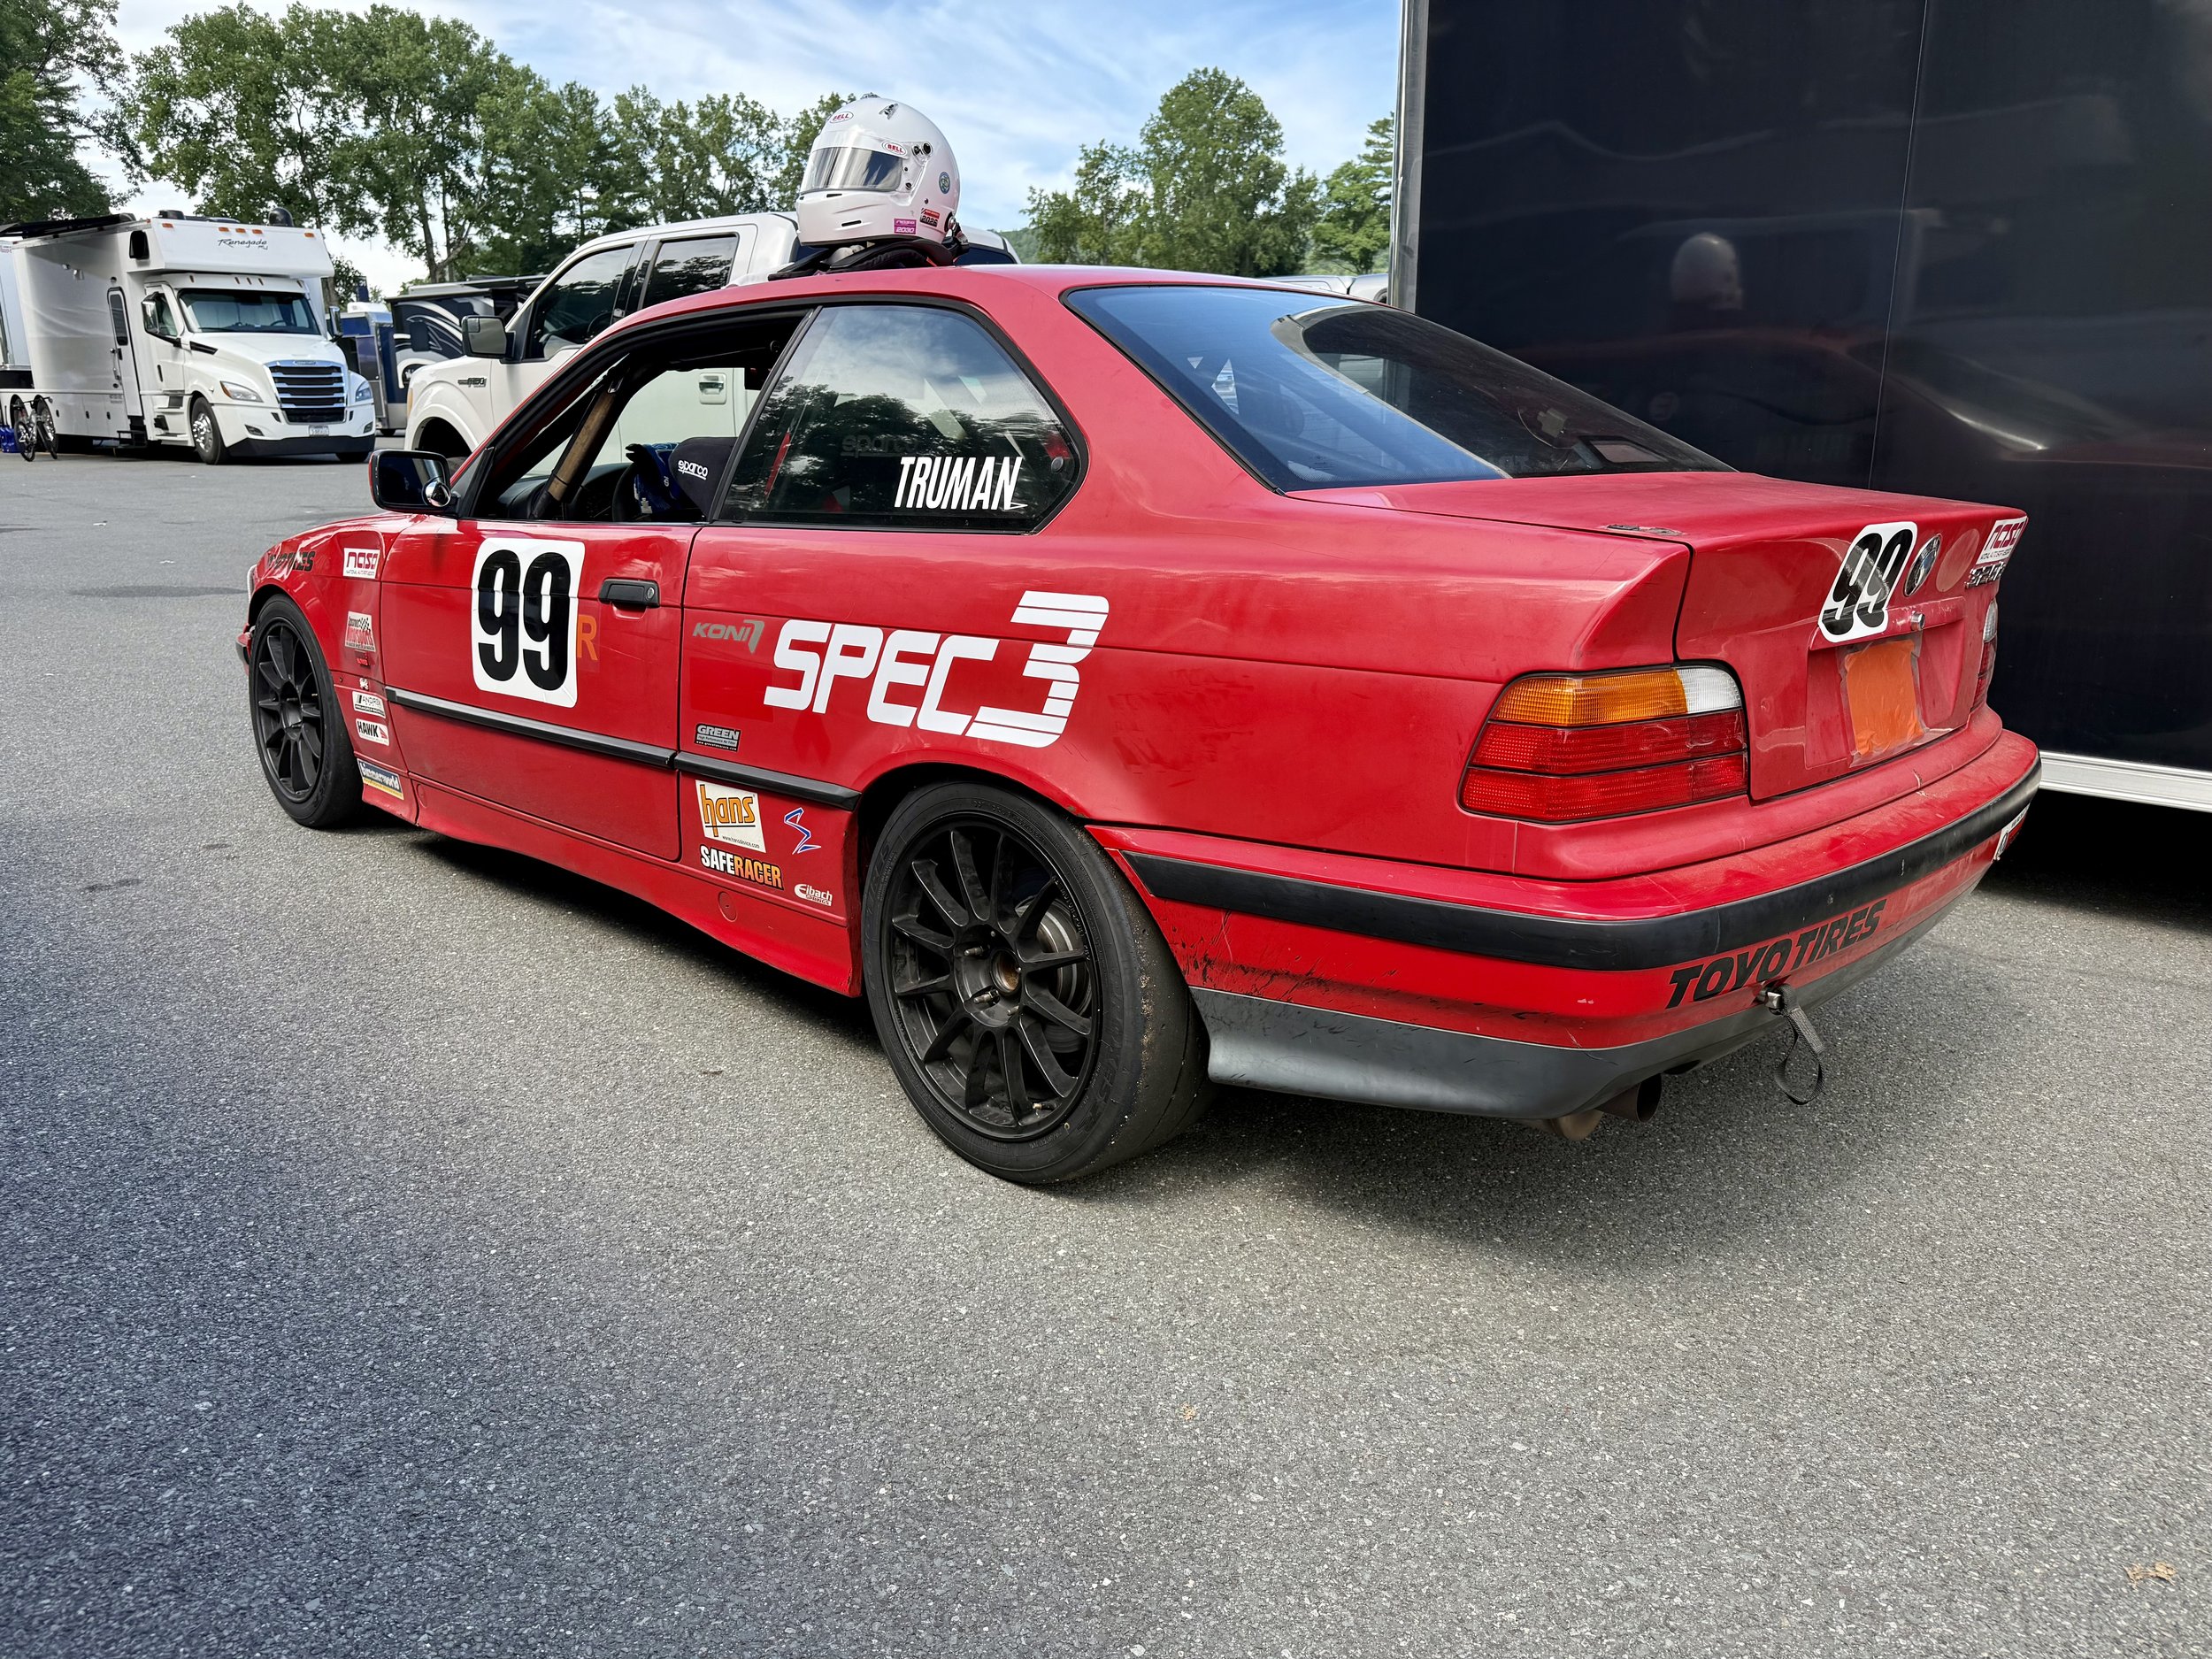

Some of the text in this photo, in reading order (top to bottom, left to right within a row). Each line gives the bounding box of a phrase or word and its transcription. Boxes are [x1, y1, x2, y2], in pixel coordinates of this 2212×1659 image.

[887, 143, 903, 153] BELL
[218, 239, 267, 248] Renegade
[678, 460, 708, 480] sparco
[894, 457, 1024, 511] TRUMAN
[1821, 529, 1913, 635] 99
[478, 549, 572, 691] 99
[576, 614, 598, 661] R
[357, 720, 379, 738] HAWK
[697, 725, 740, 741] GREEN
[700, 784, 756, 837] hans
[700, 844, 783, 889] SAFERACER
[795, 883, 833, 902] Eibach
[1665, 899, 1887, 1010] TOYO TIRES
